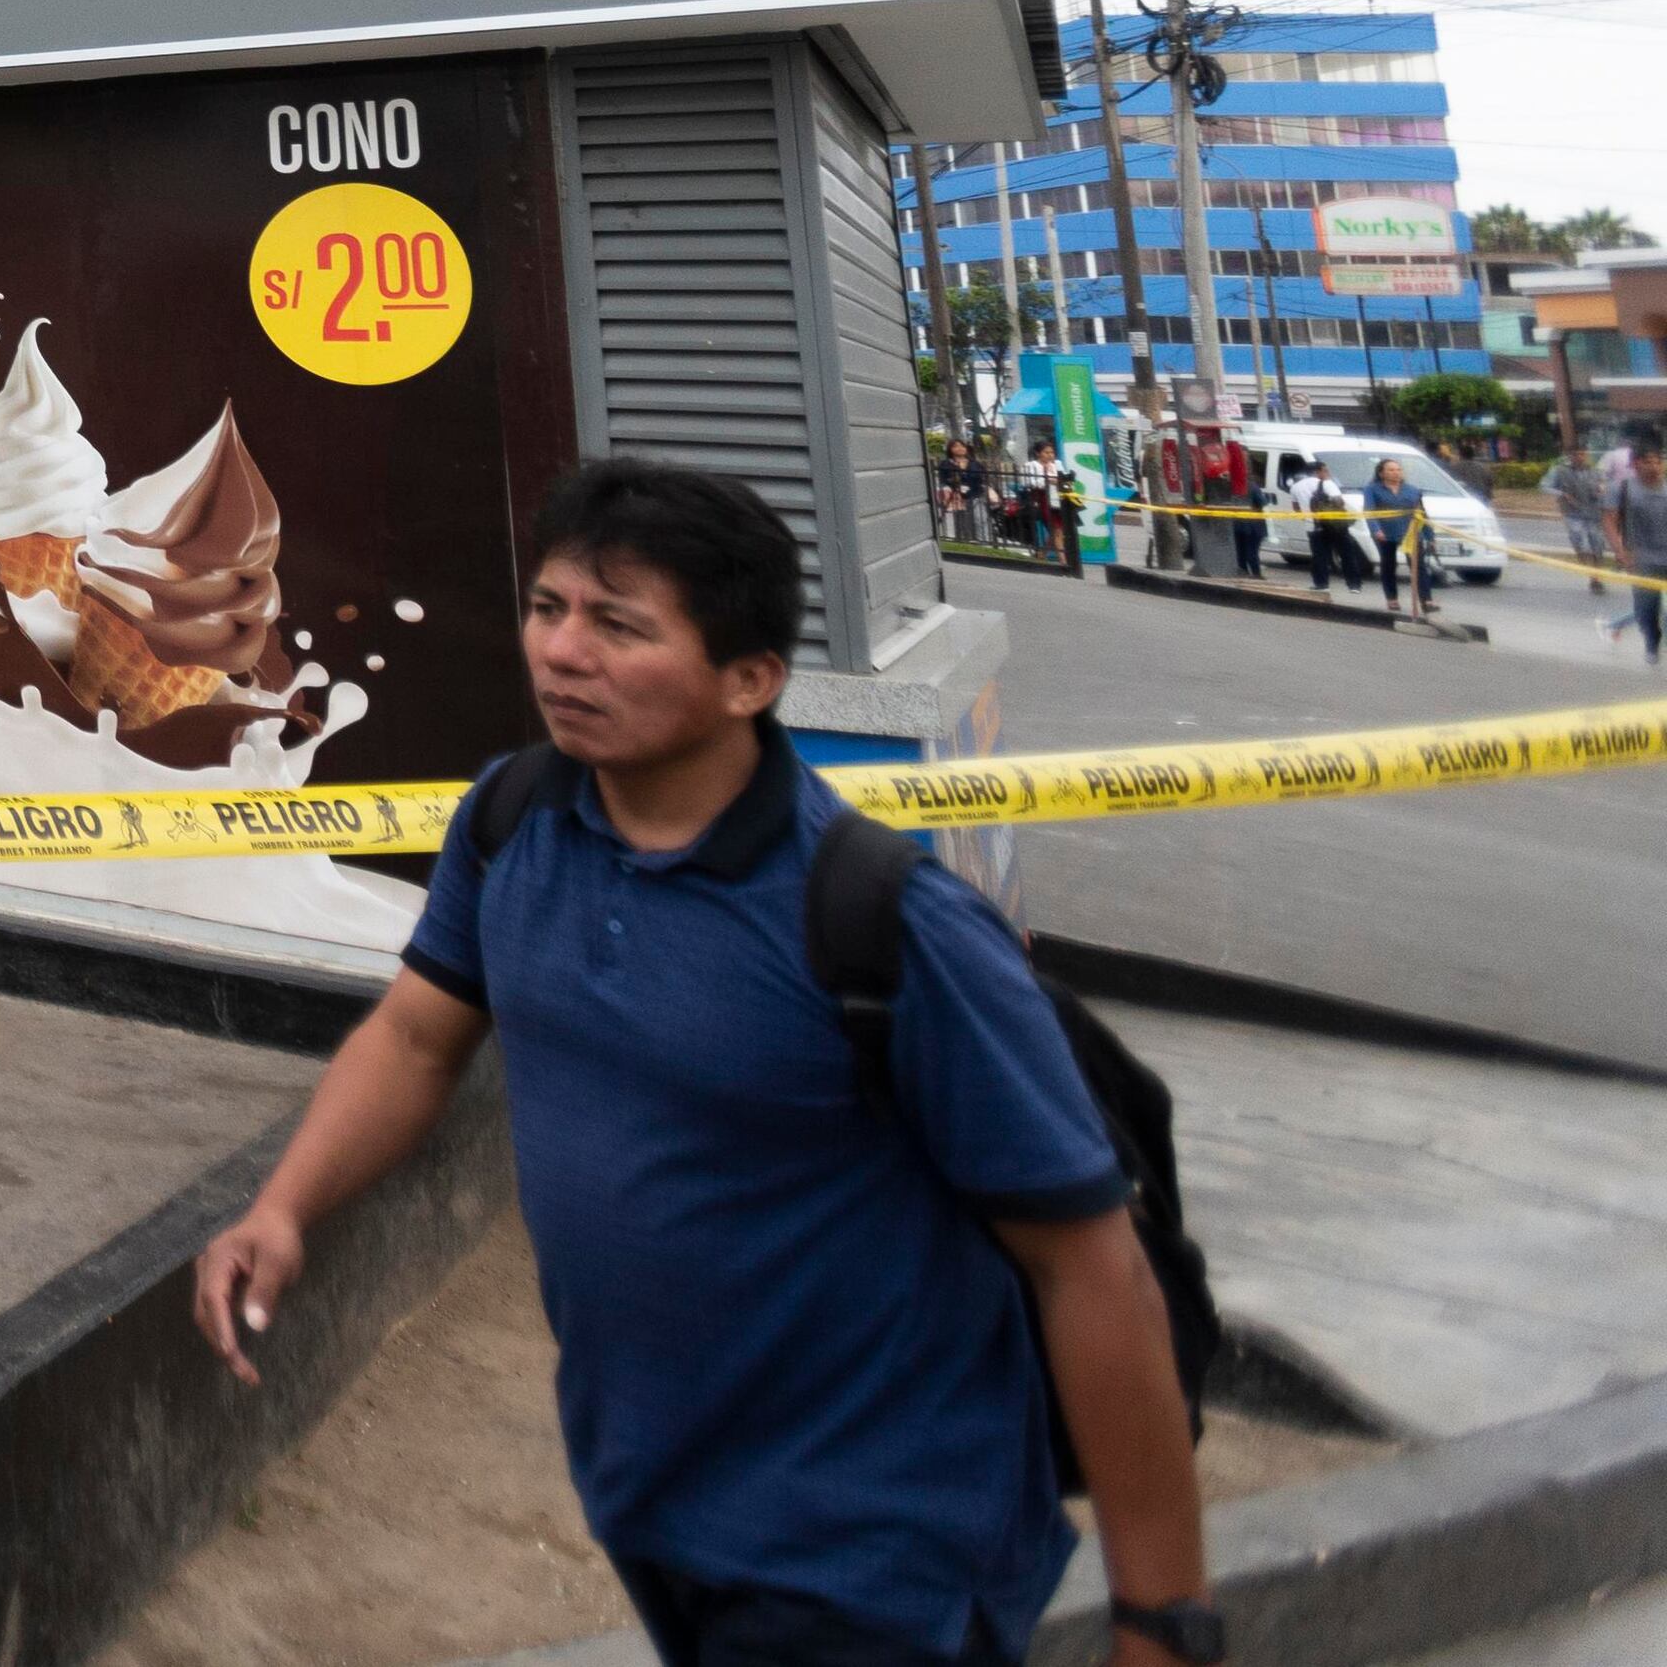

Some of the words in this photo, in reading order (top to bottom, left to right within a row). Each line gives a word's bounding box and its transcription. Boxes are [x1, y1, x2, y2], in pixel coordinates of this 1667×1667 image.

[268, 98, 421, 174] CONO
[1334, 217, 1444, 240] Norky's
[263, 270, 303, 310] S/
[1068, 382, 1085, 435] movistar
[1418, 739, 1509, 774] PELIGRO
[1569, 723, 1650, 759] PELIGRO
[1080, 764, 1191, 799] PELIGRO
[1256, 752, 1356, 787] PELIGRO
[891, 772, 1008, 809] PELIGRO
[210, 799, 364, 835] PELIGRO
[28, 844, 93, 856] TRABAJANDO
[251, 840, 295, 851] HOMBRES
[297, 838, 355, 849] TRABAJANDO
